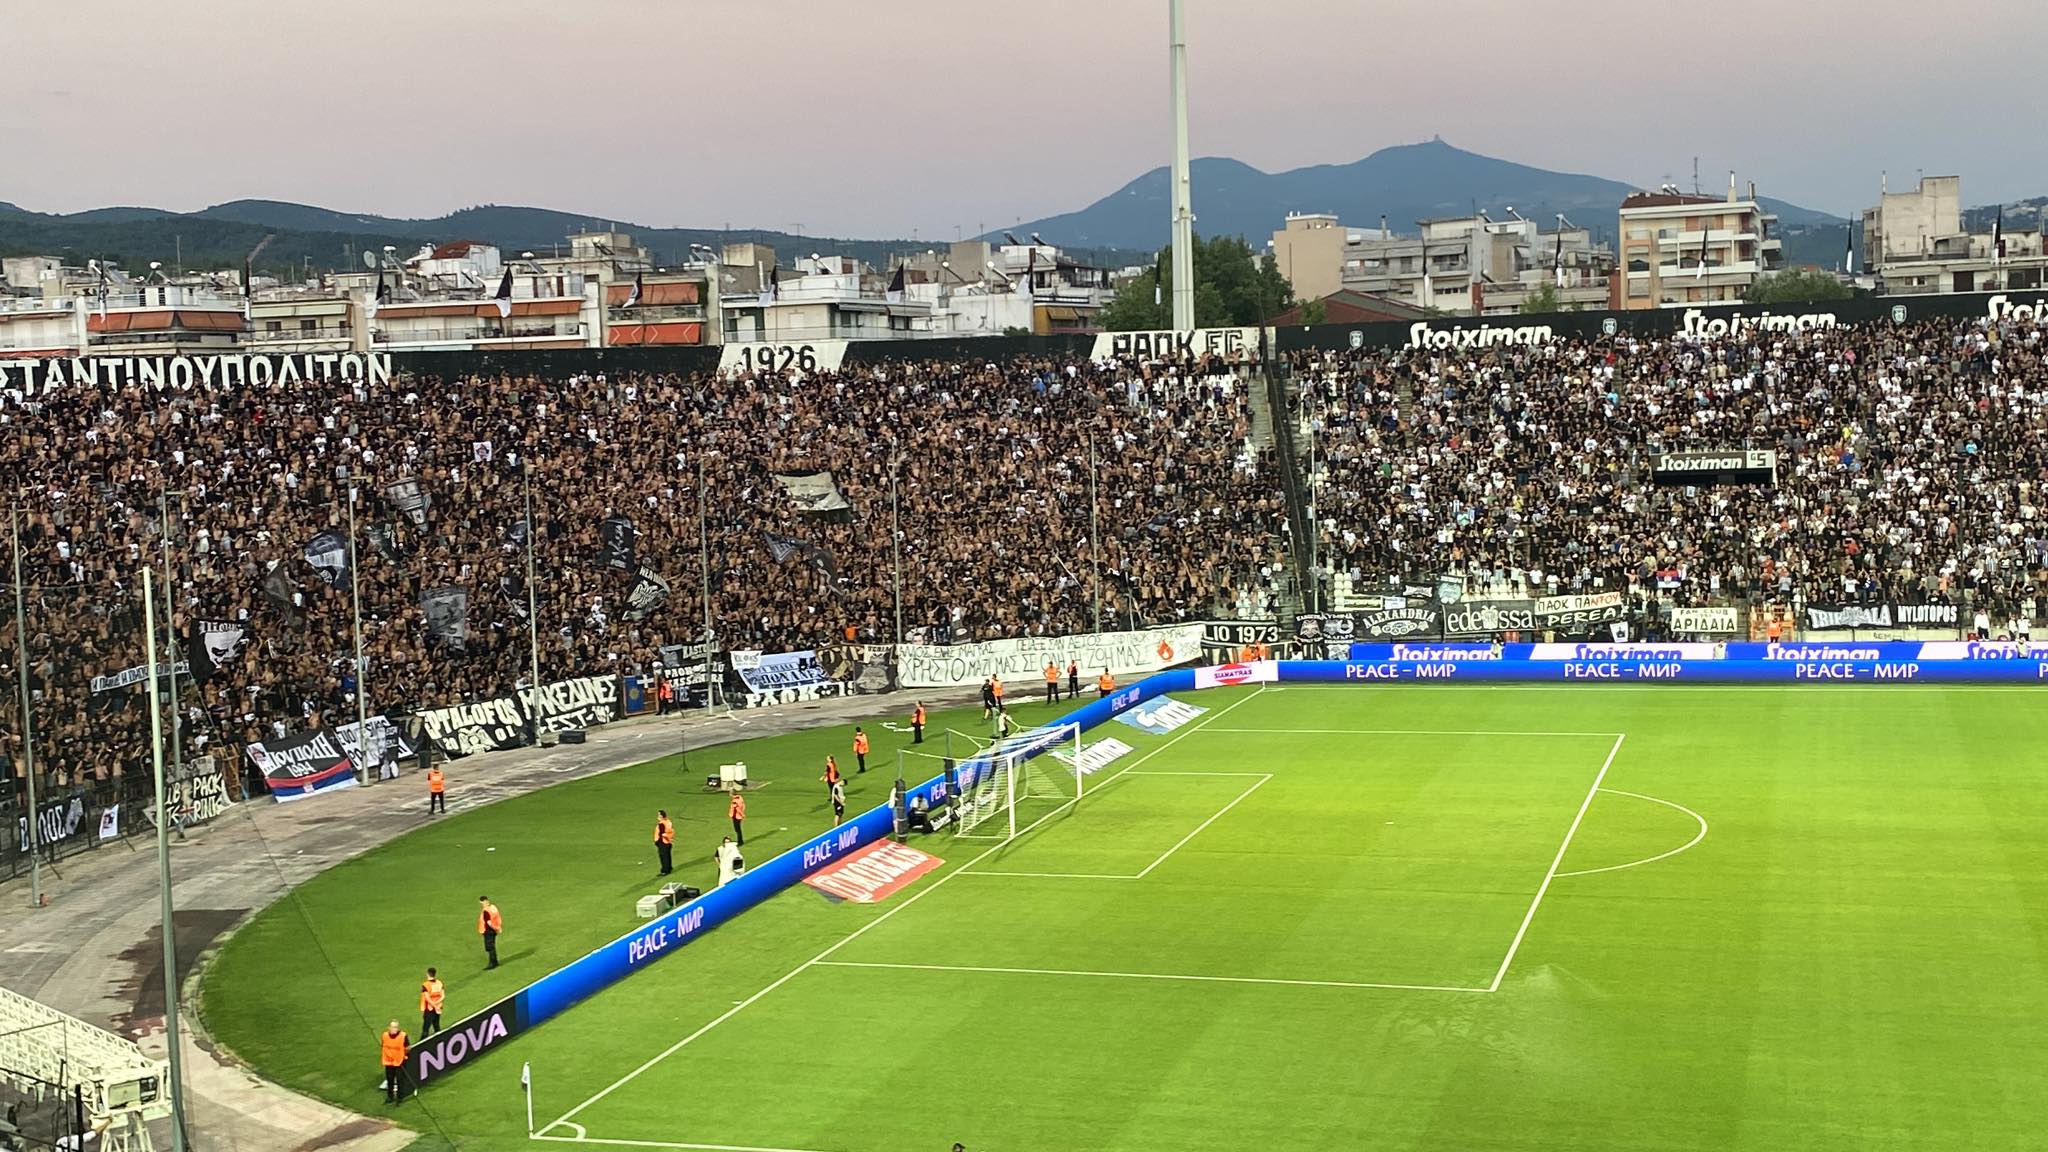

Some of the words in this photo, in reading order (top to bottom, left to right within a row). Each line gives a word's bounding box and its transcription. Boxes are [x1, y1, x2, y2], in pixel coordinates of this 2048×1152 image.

[1404, 322, 1552, 350] Stoiximan
[742, 345, 816, 375] 1926
[1657, 455, 1743, 471] Stoiximan
[1362, 608, 1436, 629] ALEXANDRIA
[1547, 607, 1616, 626] PEREA
[1673, 618, 1735, 631] ΑΡΙΔΑΙΑ
[1236, 625, 1279, 643] 1973
[1571, 644, 1682, 660] Stoiximan
[1762, 643, 1880, 660] Stoiximan
[1346, 664, 1399, 679] PEACE
[1416, 664, 1457, 679] МИР
[1564, 664, 1620, 678] PEACE
[1638, 664, 1682, 678] МИР
[1795, 664, 1855, 678] PEACE
[1874, 664, 1919, 678] МИР
[803, 839, 832, 869] PEACE
[838, 826, 859, 852] МИР
[629, 925, 668, 964] PEACE
[677, 906, 704, 938] МИР
[420, 1012, 508, 1080] NOVA
